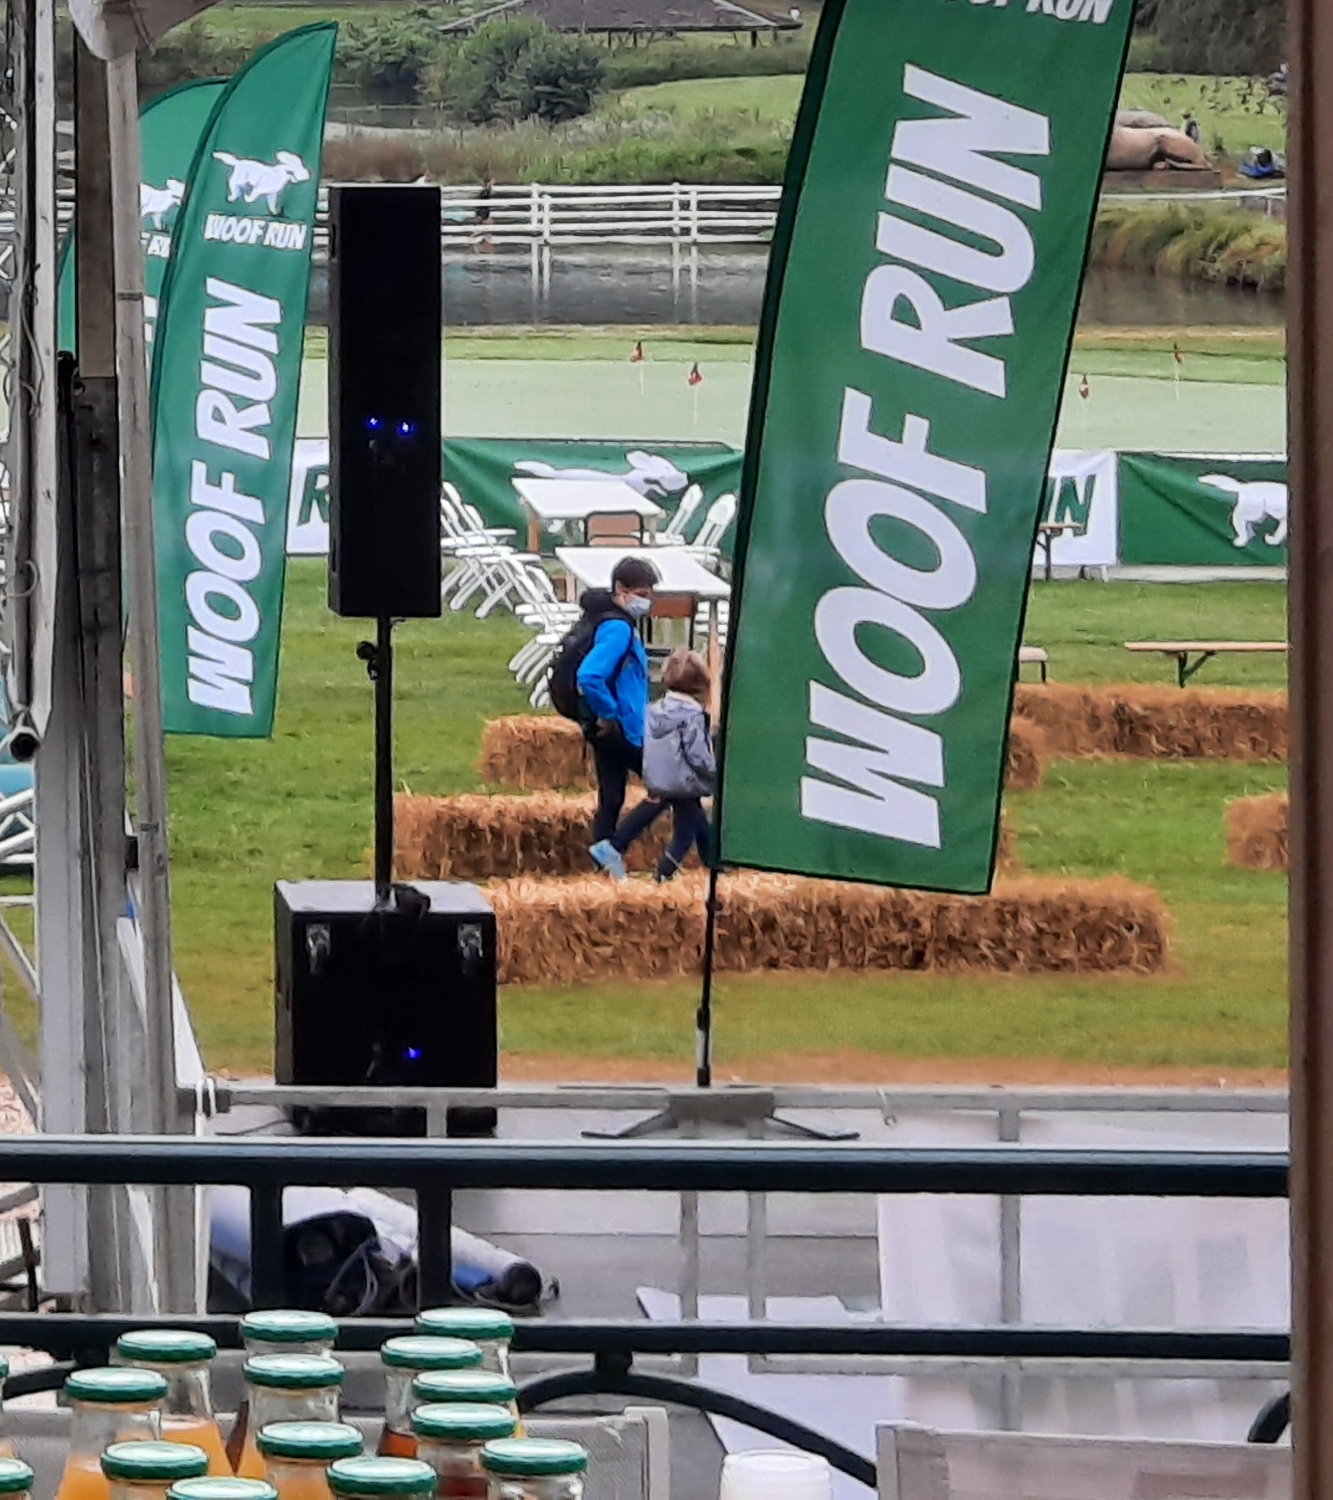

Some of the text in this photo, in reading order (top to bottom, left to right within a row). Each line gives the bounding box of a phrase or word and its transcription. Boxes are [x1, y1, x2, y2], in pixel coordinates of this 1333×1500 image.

[204, 214, 307, 250] WOOF RUN
[184, 276, 282, 715] WOOF RUN
[799, 62, 1052, 850] WOOF RUN
